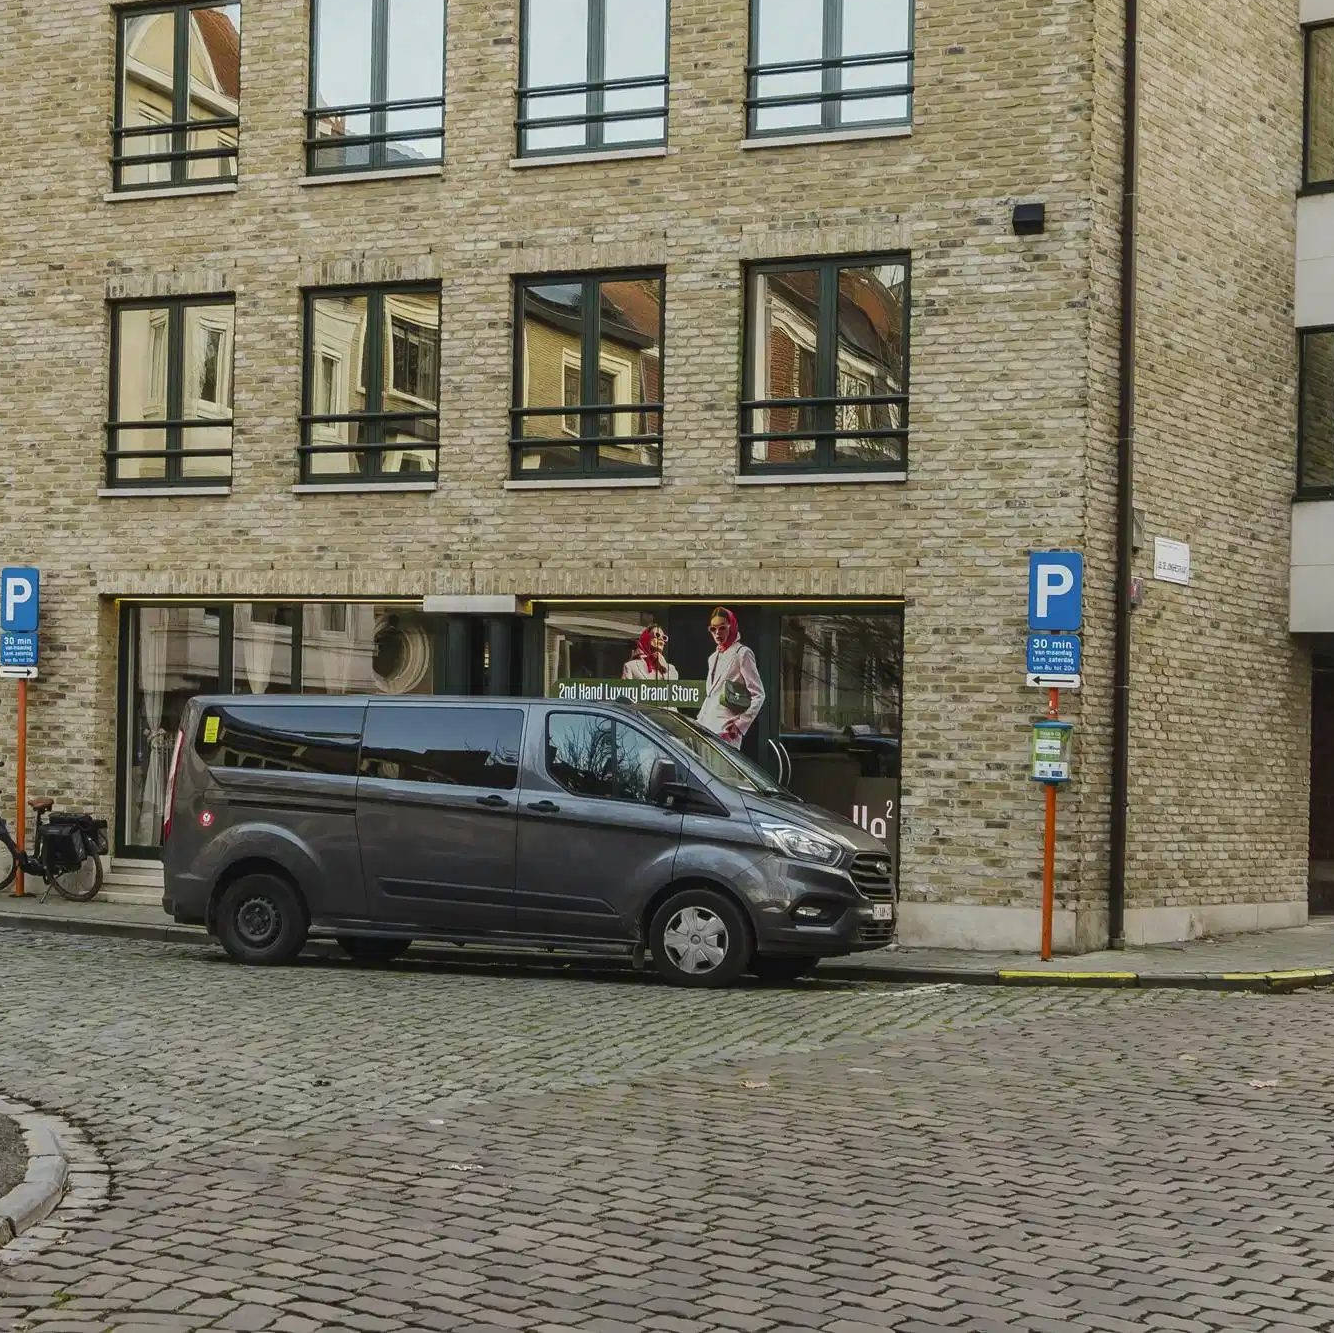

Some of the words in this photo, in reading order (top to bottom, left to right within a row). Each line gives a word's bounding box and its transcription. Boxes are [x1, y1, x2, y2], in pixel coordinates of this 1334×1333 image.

[5, 577, 33, 621] P
[1036, 564, 1074, 618] P
[4, 636, 15, 645] 30
[1032, 638, 1048, 649] 30
[1051, 639, 1075, 649] min.
[558, 682, 577, 699] 2nd
[579, 683, 603, 701] Hand
[605, 683, 639, 704] Luxury
[640, 684, 669, 702] Brand
[671, 684, 700, 703] Store
